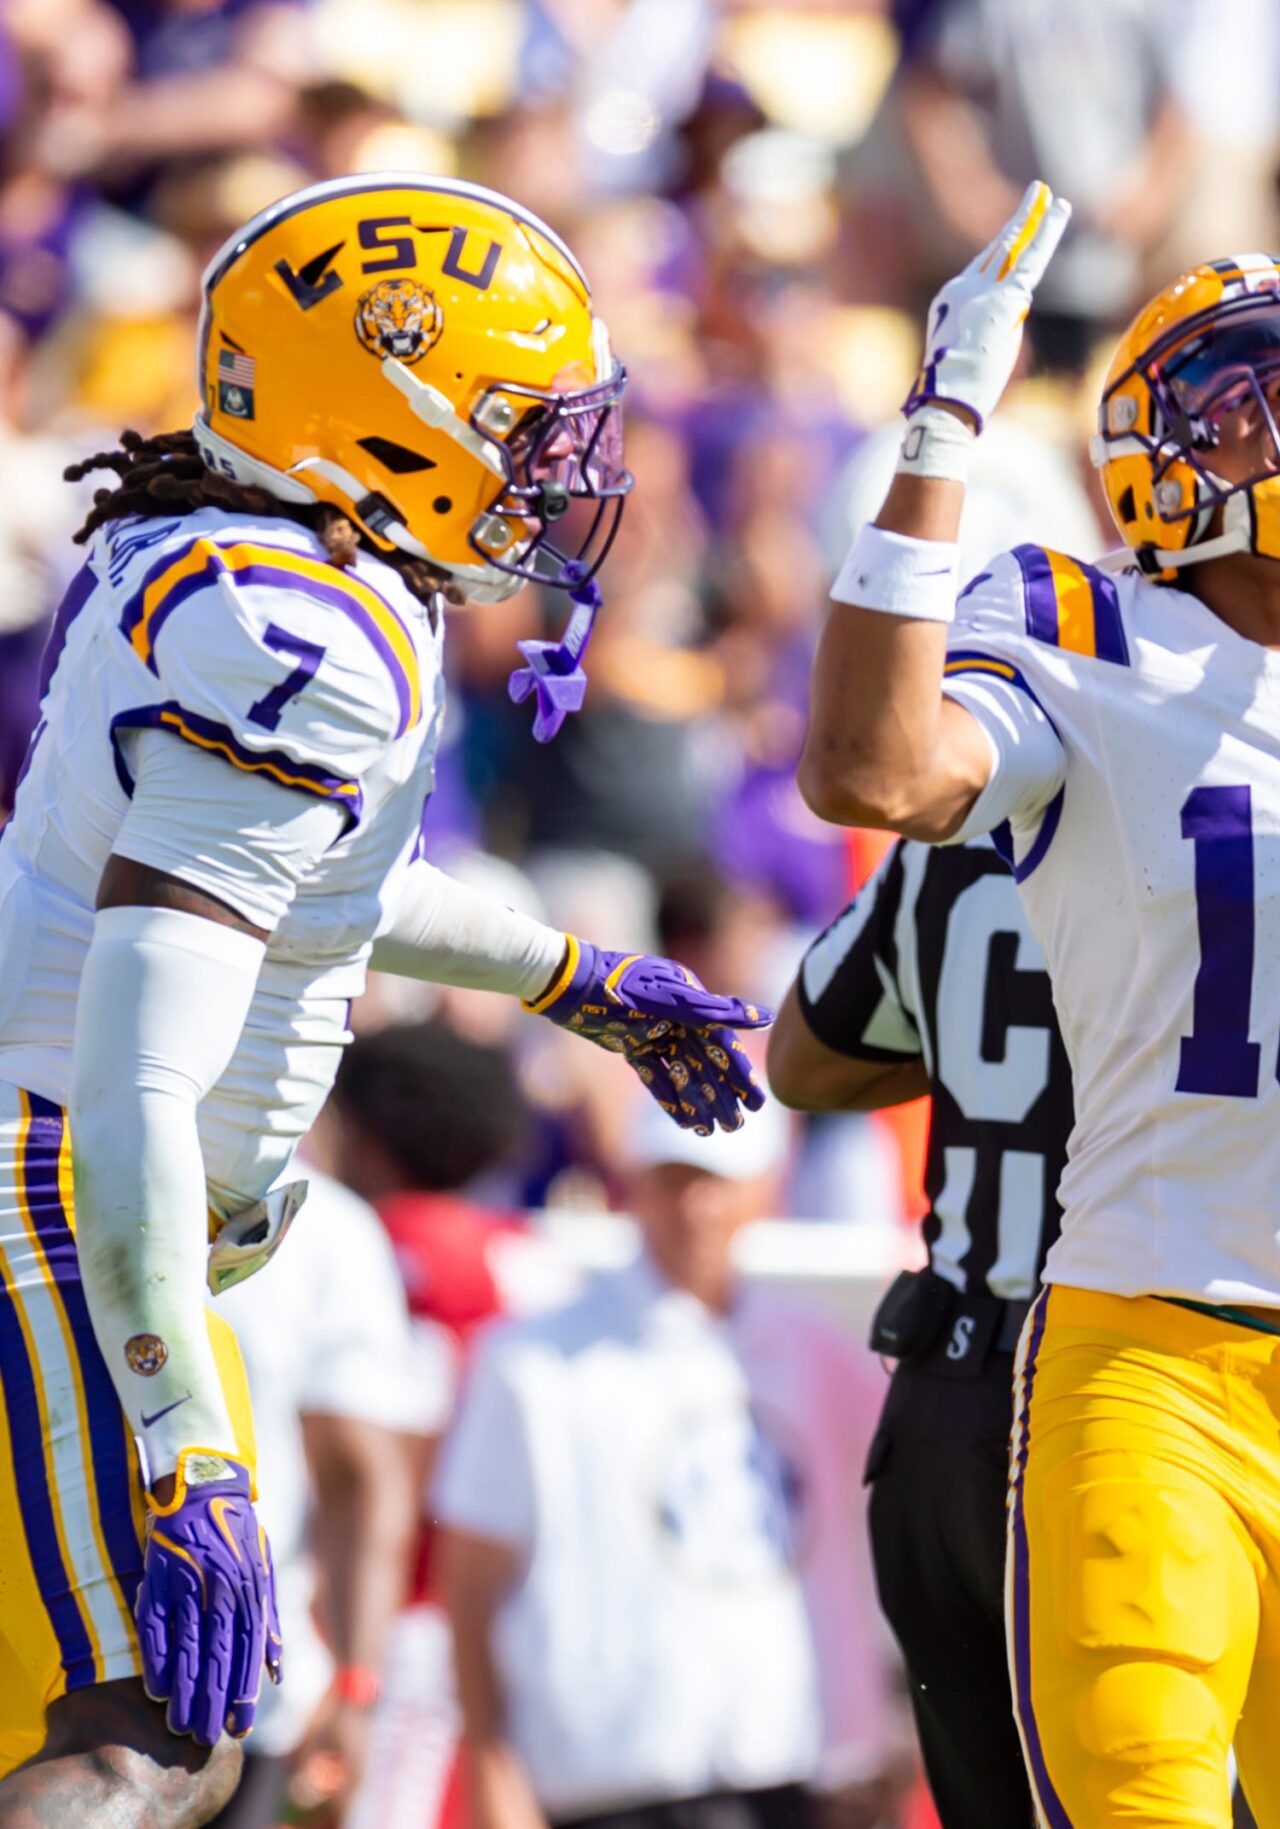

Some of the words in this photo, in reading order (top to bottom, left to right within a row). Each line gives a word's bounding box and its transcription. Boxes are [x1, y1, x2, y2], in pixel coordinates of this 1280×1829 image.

[273, 216, 503, 312] LSU
[246, 622, 327, 733] 7
[936, 873, 1052, 1124] C
[946, 1316, 975, 1360] S
